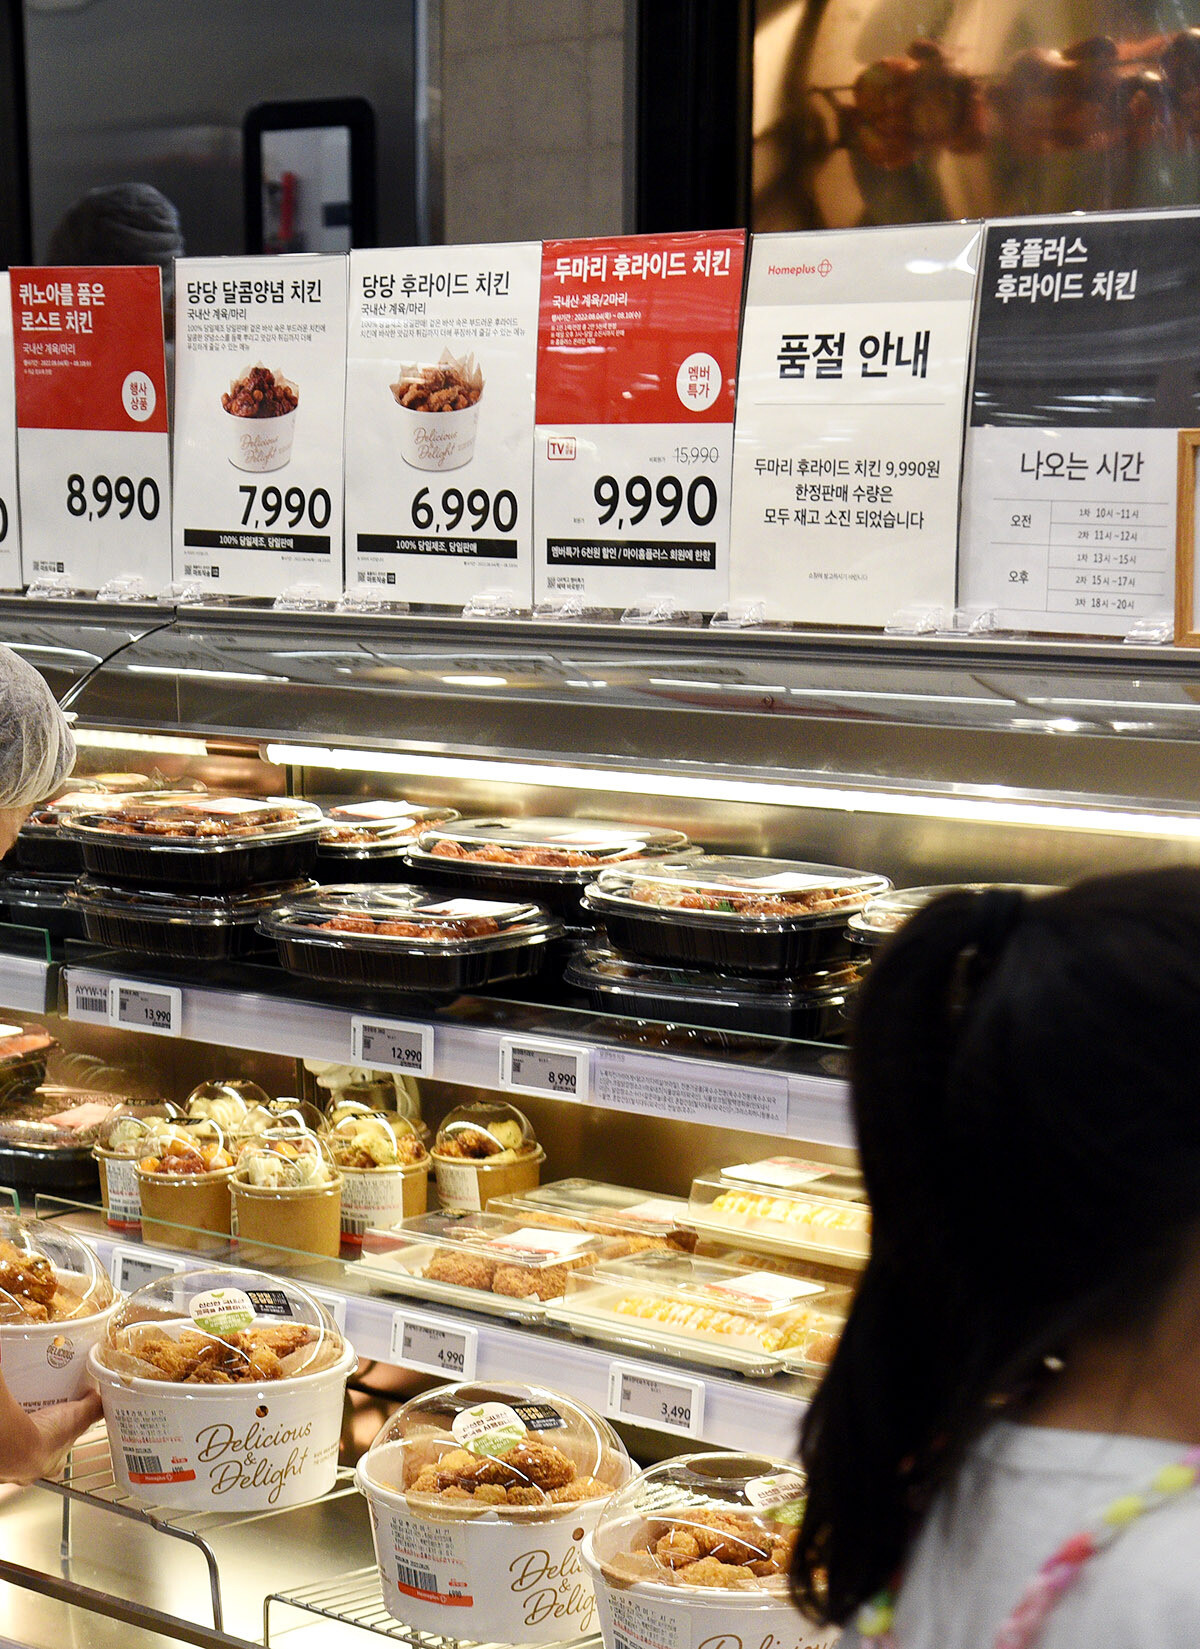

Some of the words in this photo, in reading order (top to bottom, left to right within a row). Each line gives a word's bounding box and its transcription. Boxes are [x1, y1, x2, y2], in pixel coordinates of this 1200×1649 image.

[998, 237, 1088, 268] 홈플러스
[553, 255, 607, 284] 두마리
[612, 252, 687, 281] 후라이드
[692, 248, 731, 277] 치킨
[768, 264, 816, 277] Homeplus
[187, 280, 218, 304] 당당
[223, 280, 284, 304] 달콤양념
[291, 279, 322, 304] 치킨
[362, 274, 396, 299] 당당
[401, 272, 469, 298] 후라이드
[475, 271, 510, 296] 치킨
[995, 271, 1084, 304] 후라이드
[1091, 269, 1138, 301] 치킨
[19, 282, 74, 306] 퀴노아를
[77, 282, 105, 306] 품은
[552, 295, 578, 309] 국내산
[581, 293, 628, 308] 계육/2마리
[187, 308, 210, 320] 국내산
[212, 308, 247, 320] 계육/마리
[361, 303, 386, 316] 국내산
[388, 302, 426, 315] 계육/마리
[21, 311, 62, 331] 로스트
[65, 310, 93, 334] 치킨
[22, 343, 43, 355] 국내산
[777, 332, 845, 379] 품절
[859, 330, 930, 378] 안내
[688, 365, 710, 381] 멤버
[130, 382, 147, 396] 행사
[687, 383, 710, 399] 특가
[130, 397, 148, 411] 상품
[413, 427, 458, 445] Delicious
[418, 442, 456, 467] Delight
[550, 443, 565, 455] TV
[673, 447, 719, 465] 15,990
[754, 458, 792, 476] 두마리
[797, 459, 850, 477] 후라이드
[854, 460, 881, 477] 치킨
[885, 460, 940, 479] 9,990원
[1020, 450, 1089, 482] 나오는
[1096, 451, 1144, 482] 시간
[67, 474, 160, 522] 8,990
[795, 484, 848, 502] 한정판매
[852, 485, 893, 503] 수량은
[239, 485, 332, 529] 7,990
[411, 487, 518, 533] 6,990
[594, 475, 718, 530] 9,990
[764, 508, 790, 526] 모두
[793, 509, 820, 526] 재고
[824, 510, 851, 527] 소진
[855, 511, 924, 529] 되었습니다
[1010, 514, 1032, 528] 오전
[1079, 508, 1091, 518] 1차
[219, 535, 238, 546] 100%
[1078, 531, 1089, 540] 2차
[396, 539, 416, 550] 100%
[449, 542, 478, 554] 당일판매
[551, 546, 580, 559] 멤버특가
[581, 547, 601, 559] 6천원
[602, 547, 617, 560] 할인
[623, 549, 669, 561] 마이홈플러스
[670, 549, 694, 561] 회원에
[695, 550, 711, 562] 한함
[1077, 554, 1088, 562] 1차
[1008, 570, 1029, 584] 오후
[1075, 576, 1087, 585] 2차
[75, 985, 107, 998] AYYW-14
[144, 1008, 171, 1023] 13,990
[392, 1046, 422, 1062] 12,990
[548, 1071, 576, 1087] 8,990
[438, 1349, 465, 1366] 4,990
[661, 1402, 691, 1421] 3,490
[195, 1422, 312, 1463] Delicious
[243, 1451, 257, 1466] &
[209, 1447, 309, 1504] Delight
[559, 1578, 570, 1593] &
[523, 1584, 597, 1632] Delig
